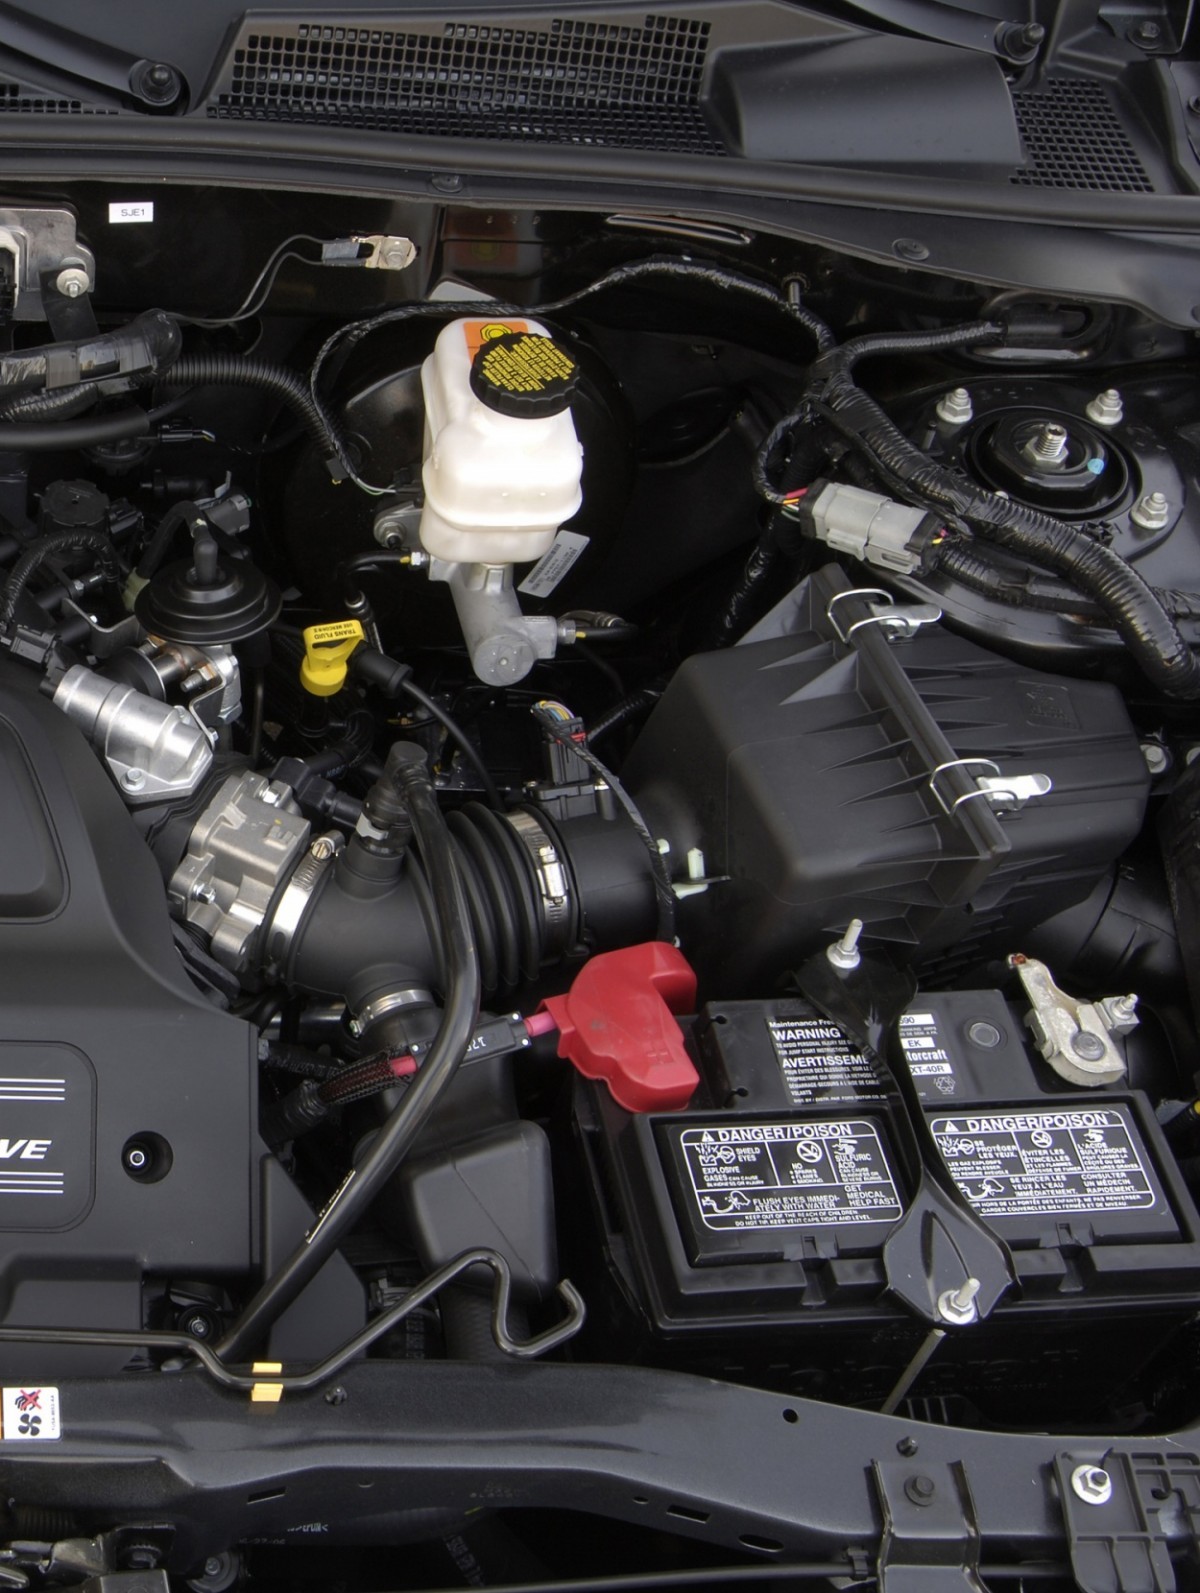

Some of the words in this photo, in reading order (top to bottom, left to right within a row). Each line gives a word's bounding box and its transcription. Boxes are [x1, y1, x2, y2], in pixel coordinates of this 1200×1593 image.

[121, 208, 144, 217] SJE1
[772, 1028, 840, 1041] WARNING
[906, 1049, 948, 1061] torcraft
[967, 1114, 1108, 1131] DANGER/POISON
[719, 1124, 852, 1142] DANGER/POISON
[736, 1147, 760, 1155] SHIELD
[738, 1154, 756, 1162] EYES
[835, 1153, 871, 1162] SULFURIC
[838, 1161, 856, 1169] ACID
[702, 1166, 740, 1174] EXPLOSIVE
[704, 1174, 728, 1182] GASES
[1081, 1172, 1126, 1180] CONSULTER
[844, 1184, 861, 1192] GET
[847, 1191, 885, 1200] MEDICAL
[753, 1198, 781, 1206] FLUSH
[783, 1196, 806, 1205] EYES
[849, 1199, 872, 1207] HELP
[873, 1197, 894, 1206] FAST
[755, 1204, 782, 1213] ATELY
[782, 1203, 805, 1211] WITH
[805, 1201, 837, 1210] WATER
